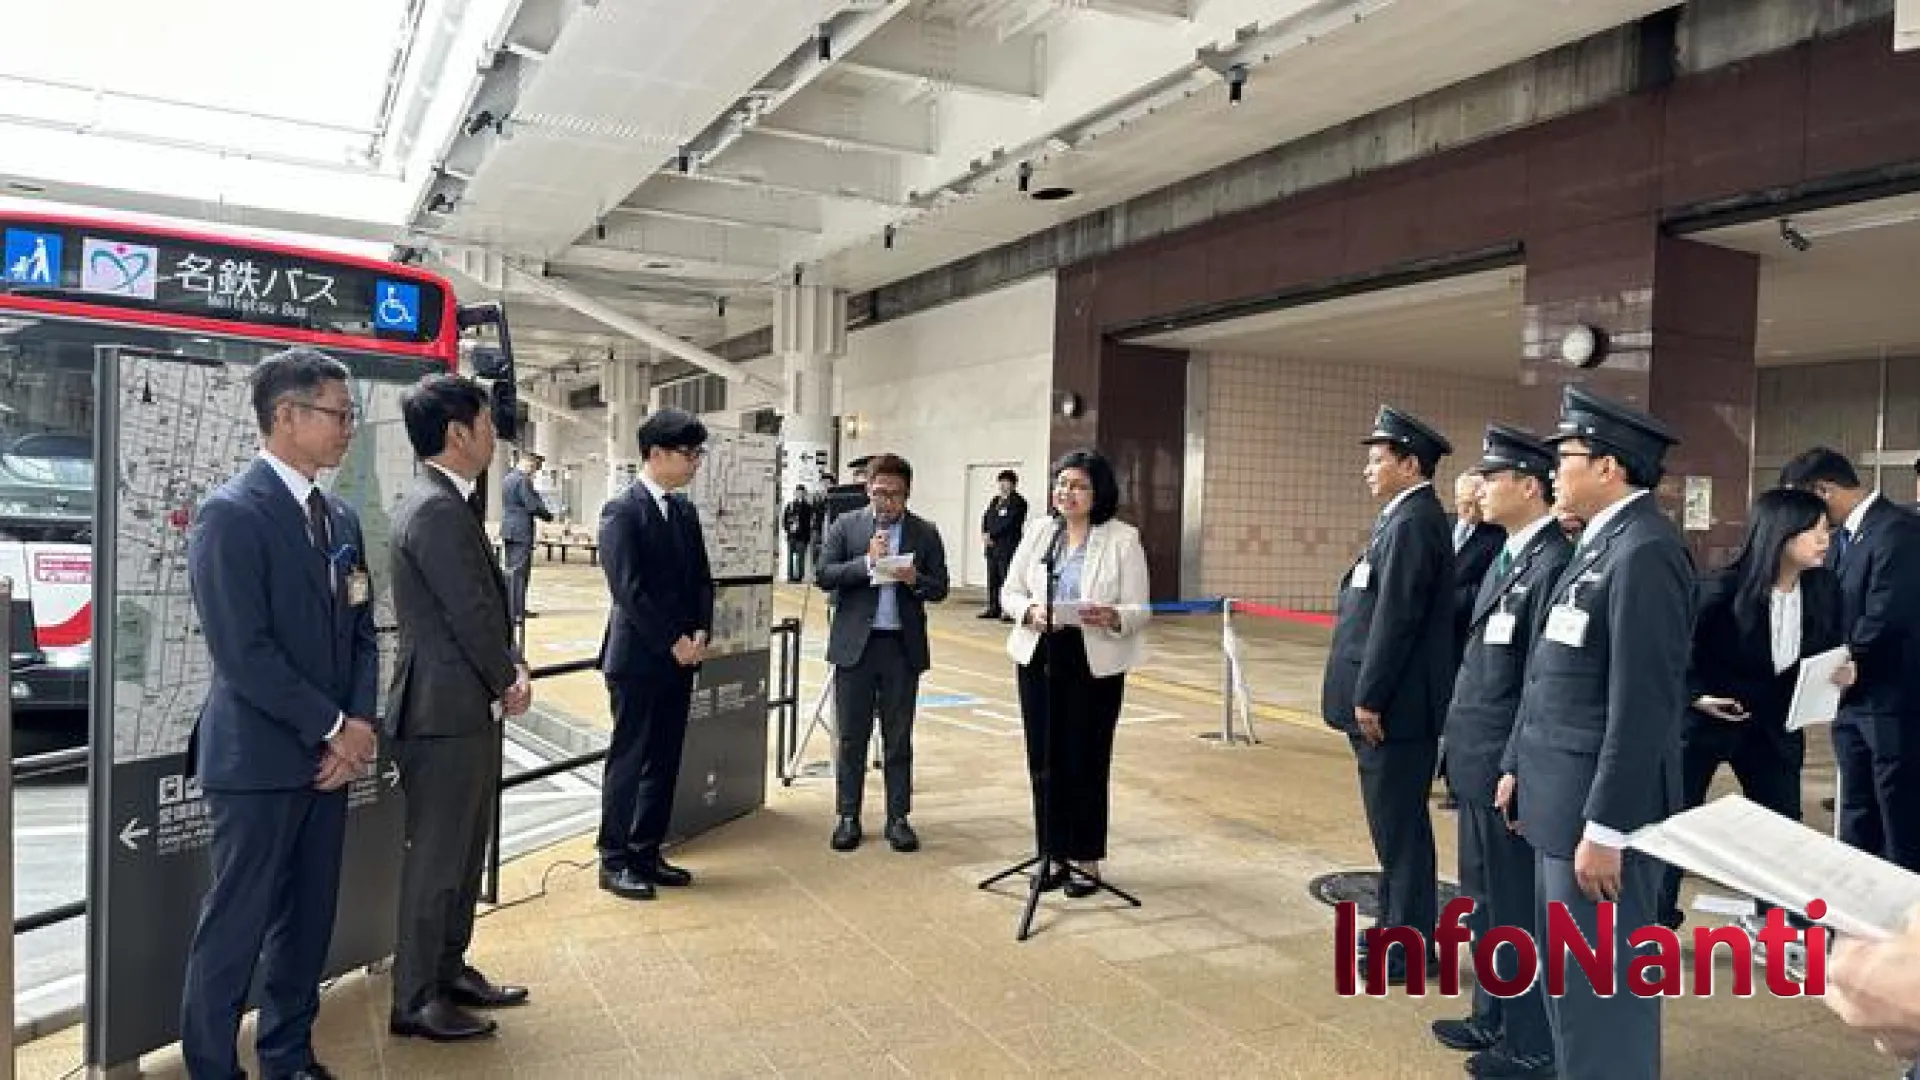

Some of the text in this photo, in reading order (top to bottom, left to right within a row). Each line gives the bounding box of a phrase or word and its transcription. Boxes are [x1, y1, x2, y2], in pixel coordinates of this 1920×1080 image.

[174, 253, 338, 306] 名鉄バス
[281, 301, 308, 319] Bus
